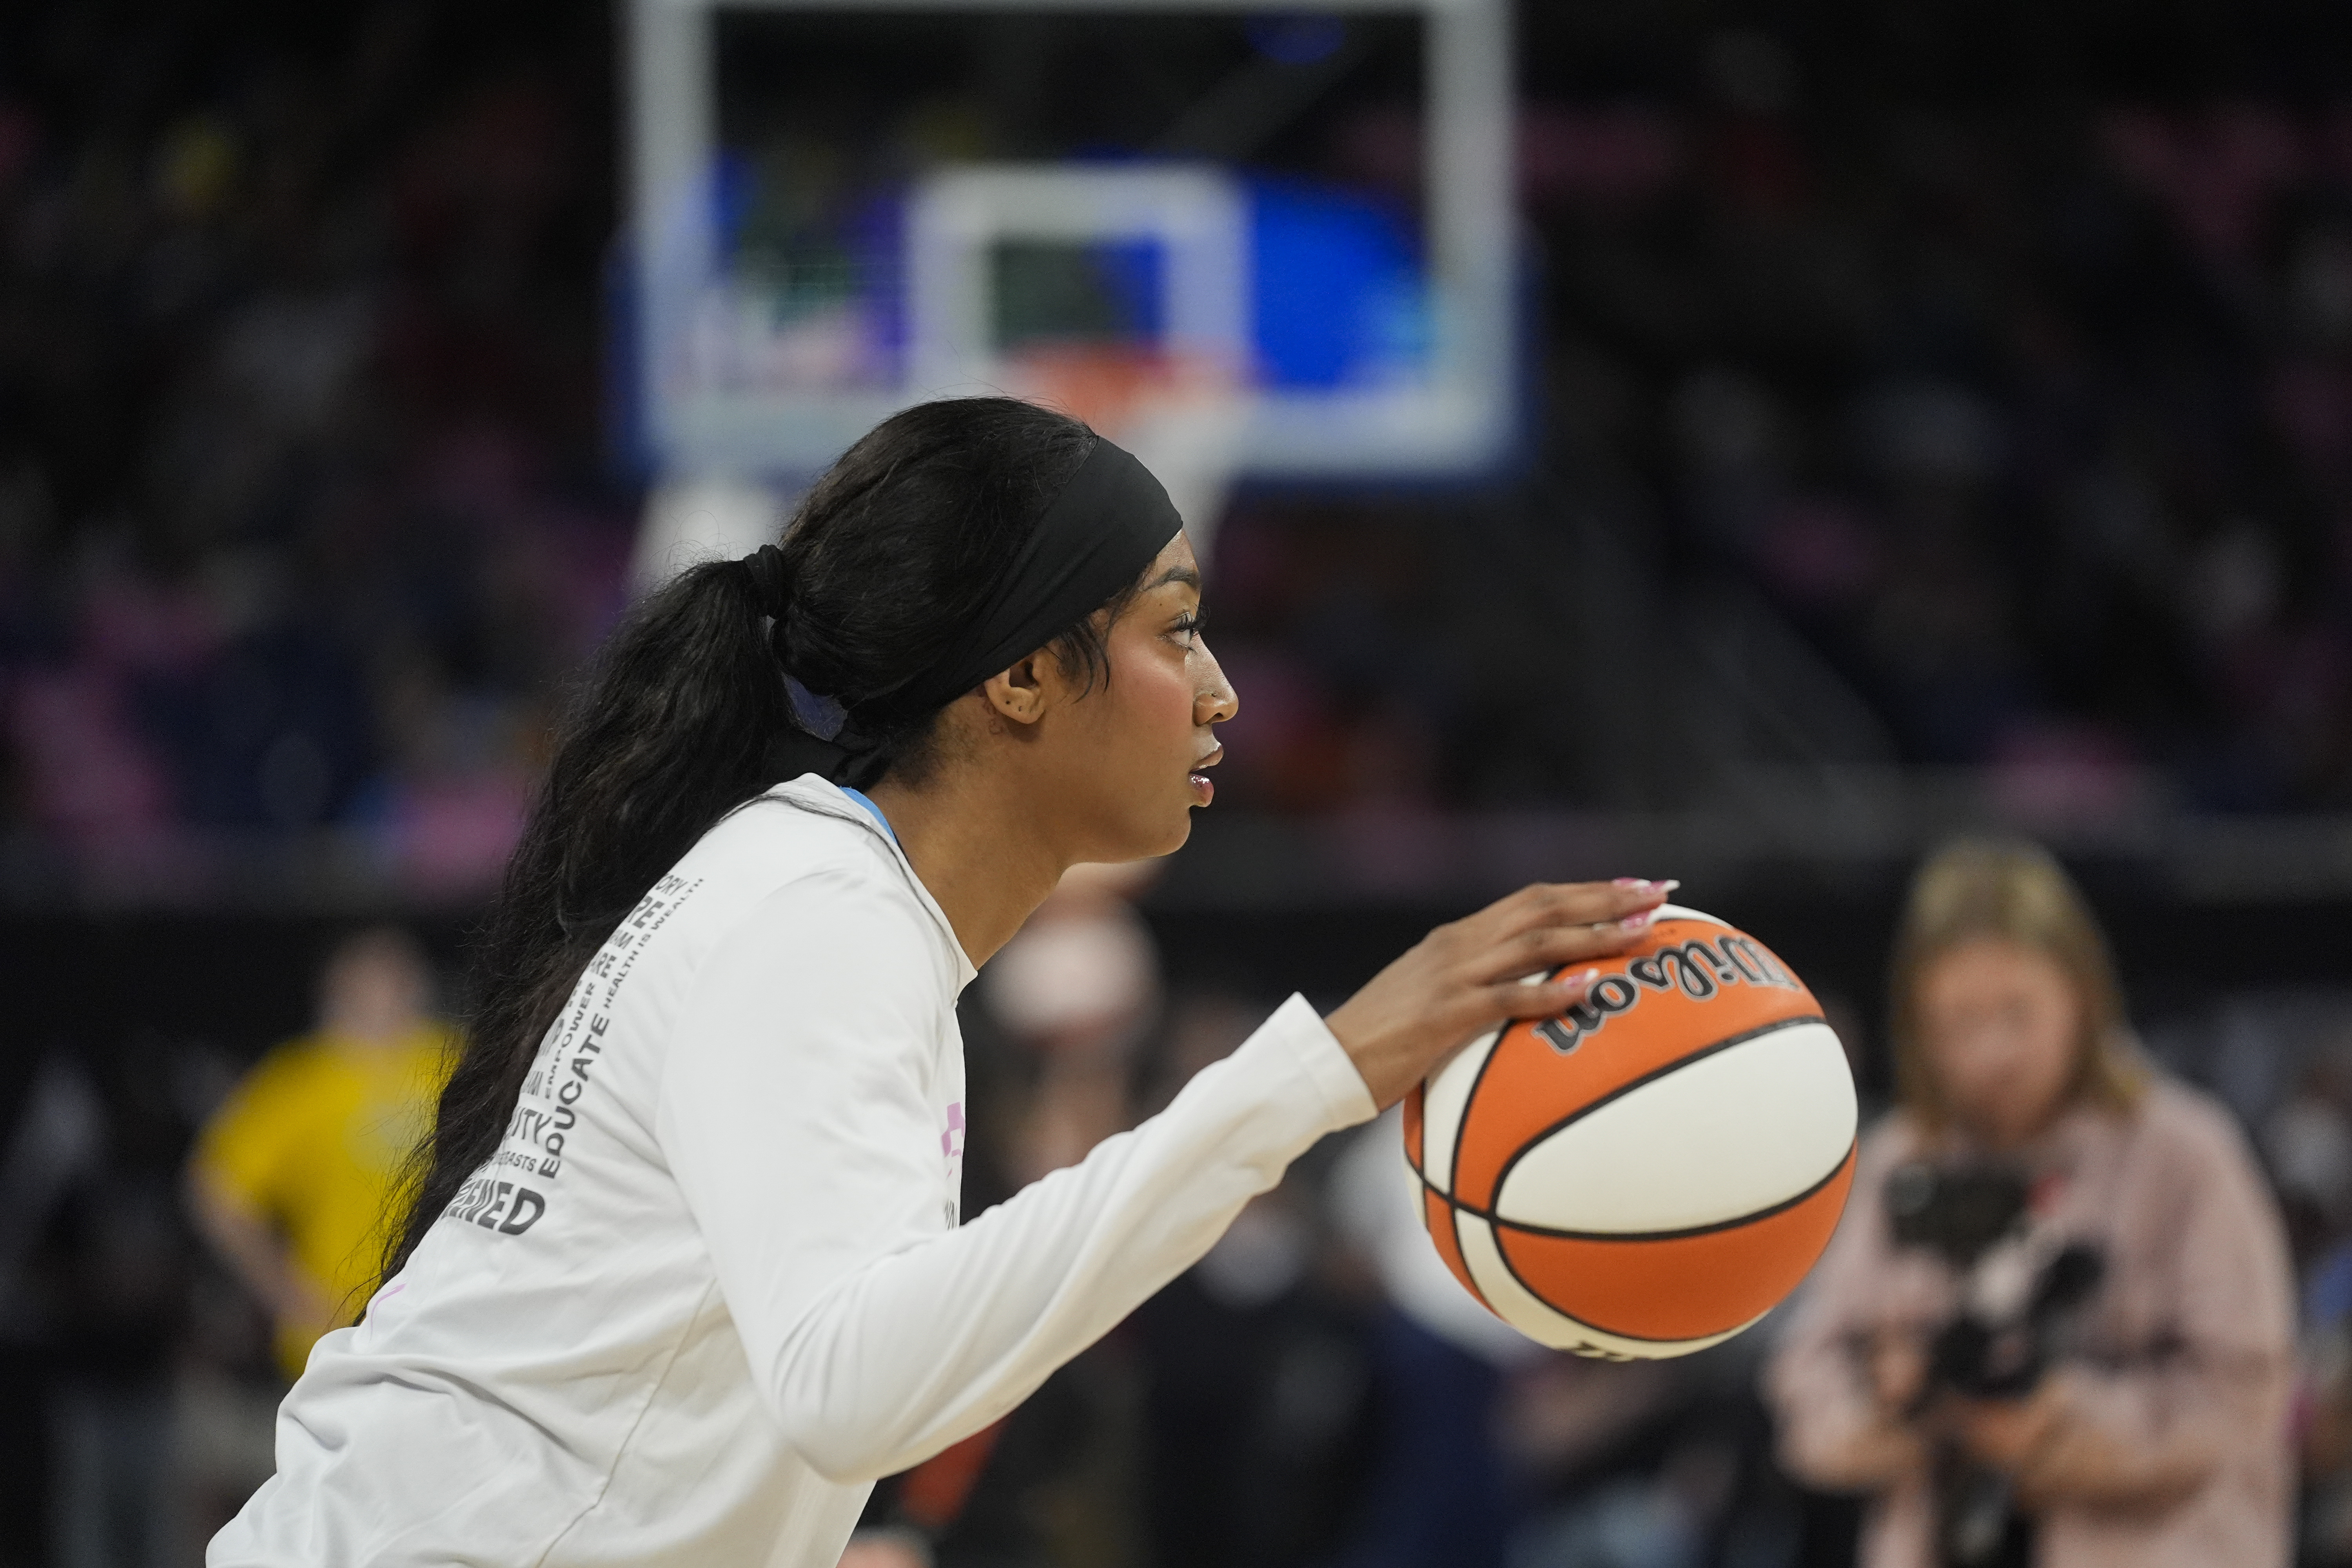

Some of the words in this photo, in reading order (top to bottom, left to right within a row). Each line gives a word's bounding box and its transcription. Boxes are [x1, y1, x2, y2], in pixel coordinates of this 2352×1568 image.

[603, 950, 639, 1009] HEALTH
[638, 933, 652, 947] IS
[650, 878, 704, 930] WEALTH
[1530, 934, 1802, 1056] Wilson
[538, 1013, 610, 1178] EDUCATE
[545, 982, 595, 1099] EMPOWER
